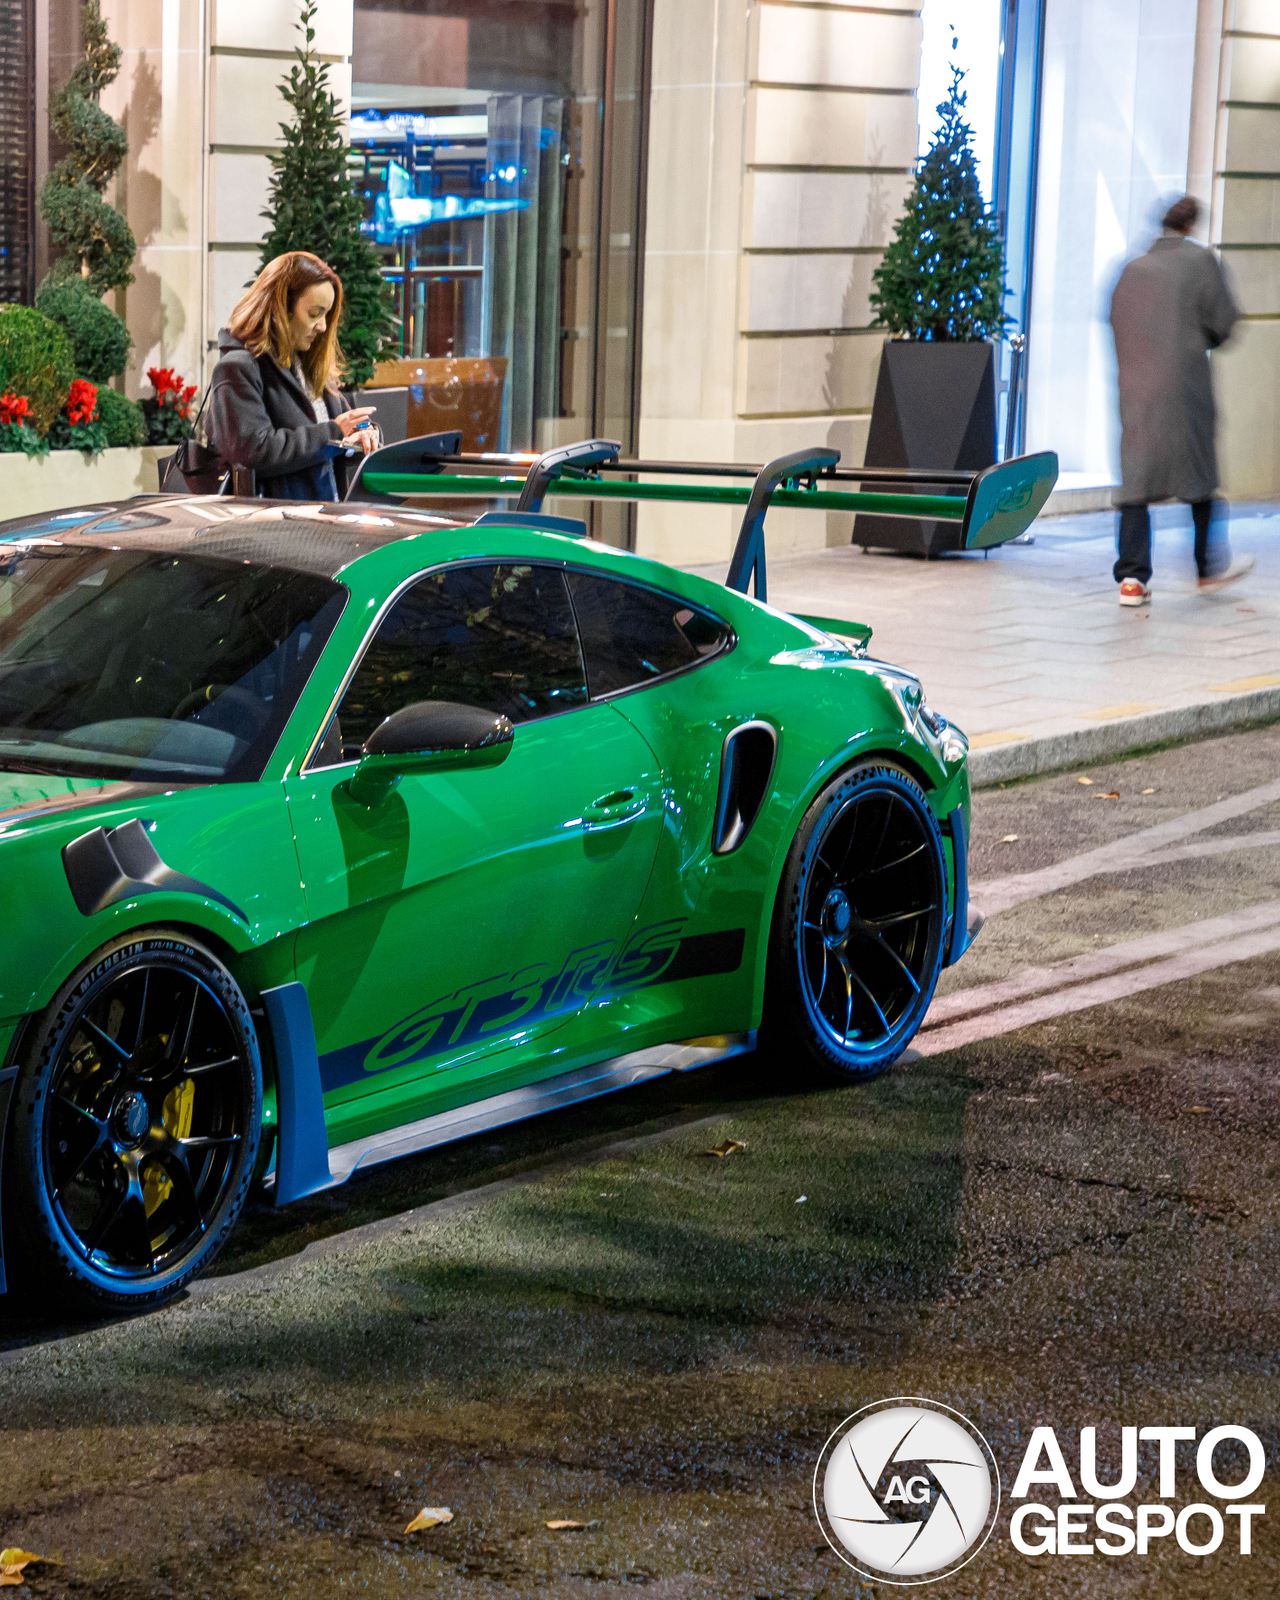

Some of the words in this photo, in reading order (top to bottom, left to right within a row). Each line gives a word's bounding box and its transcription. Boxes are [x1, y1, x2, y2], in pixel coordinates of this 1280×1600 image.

[985, 477, 1035, 520] RS
[889, 768, 930, 809] MICHELIN
[80, 942, 144, 994] MICHELIN
